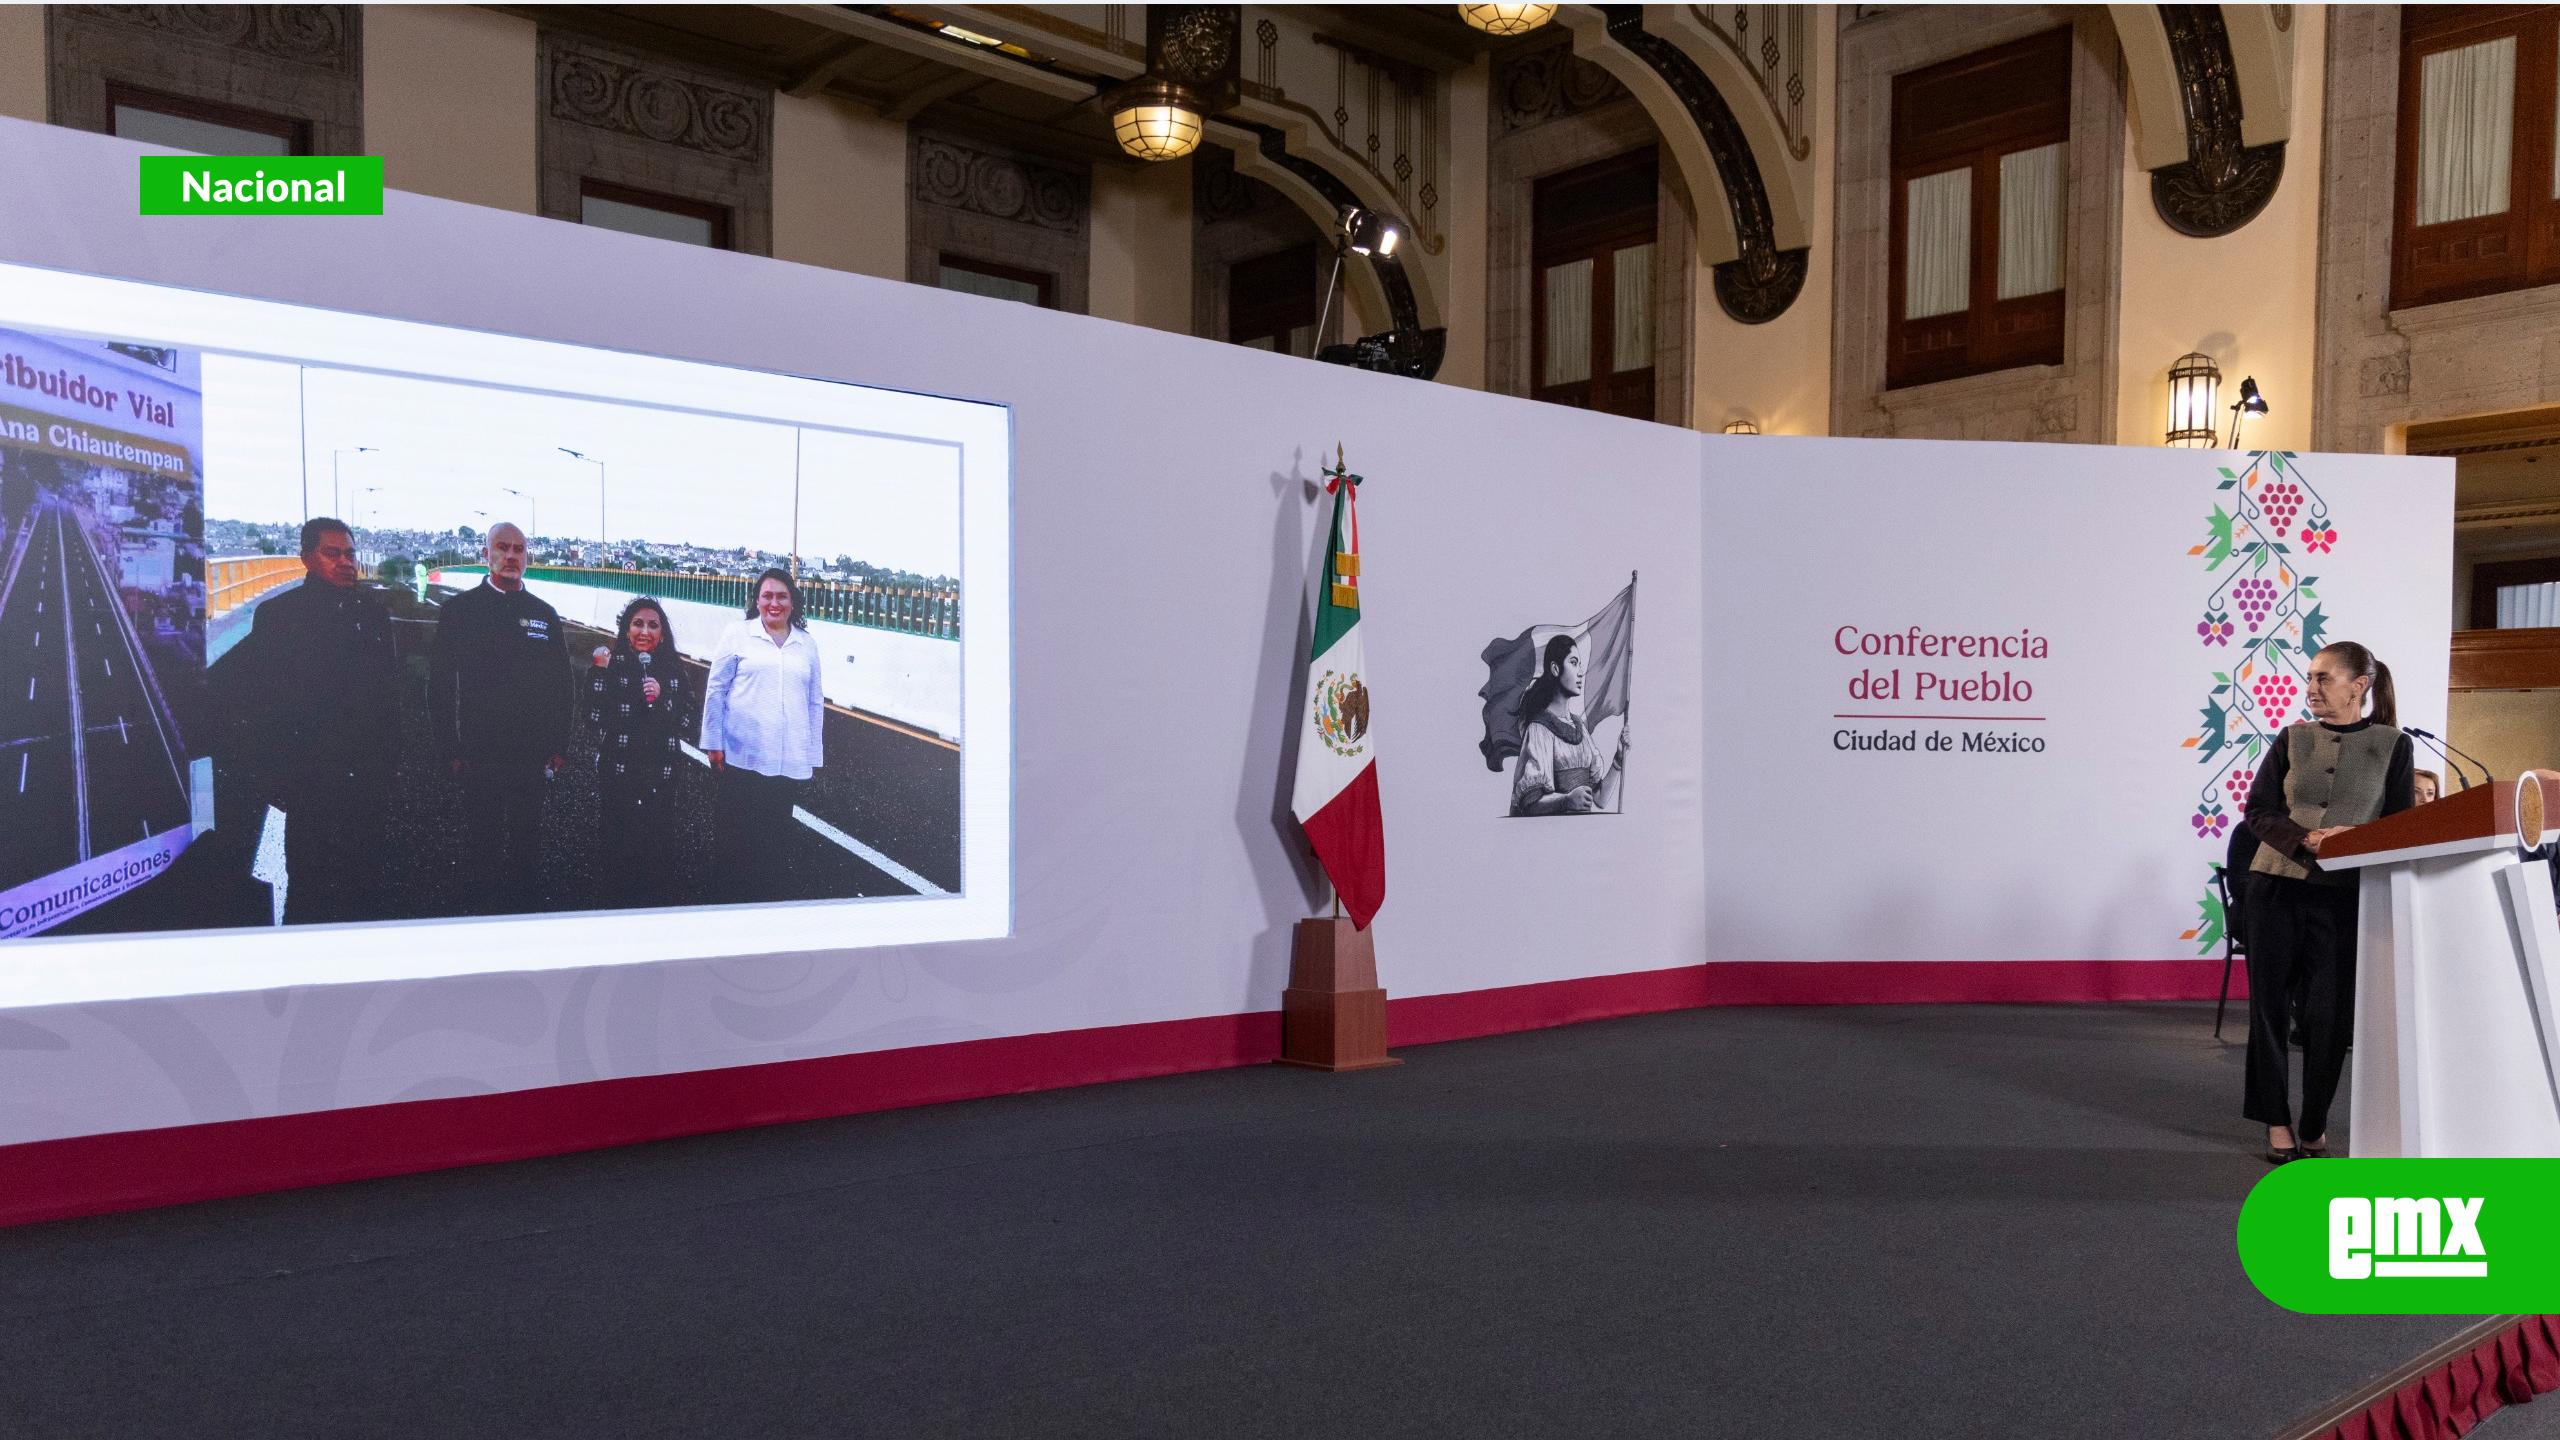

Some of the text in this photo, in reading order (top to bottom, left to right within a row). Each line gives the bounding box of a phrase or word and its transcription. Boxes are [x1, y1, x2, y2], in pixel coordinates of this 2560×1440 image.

[0, 353, 175, 428] ibuidor Vial
[49, 424, 184, 471] Chiautempan
[1834, 625, 2048, 658] Conferencia
[1848, 669, 2033, 702] del Pueblo
[1833, 729, 2045, 753] Ciudad de México
[0, 849, 171, 931] Comunicaciones
